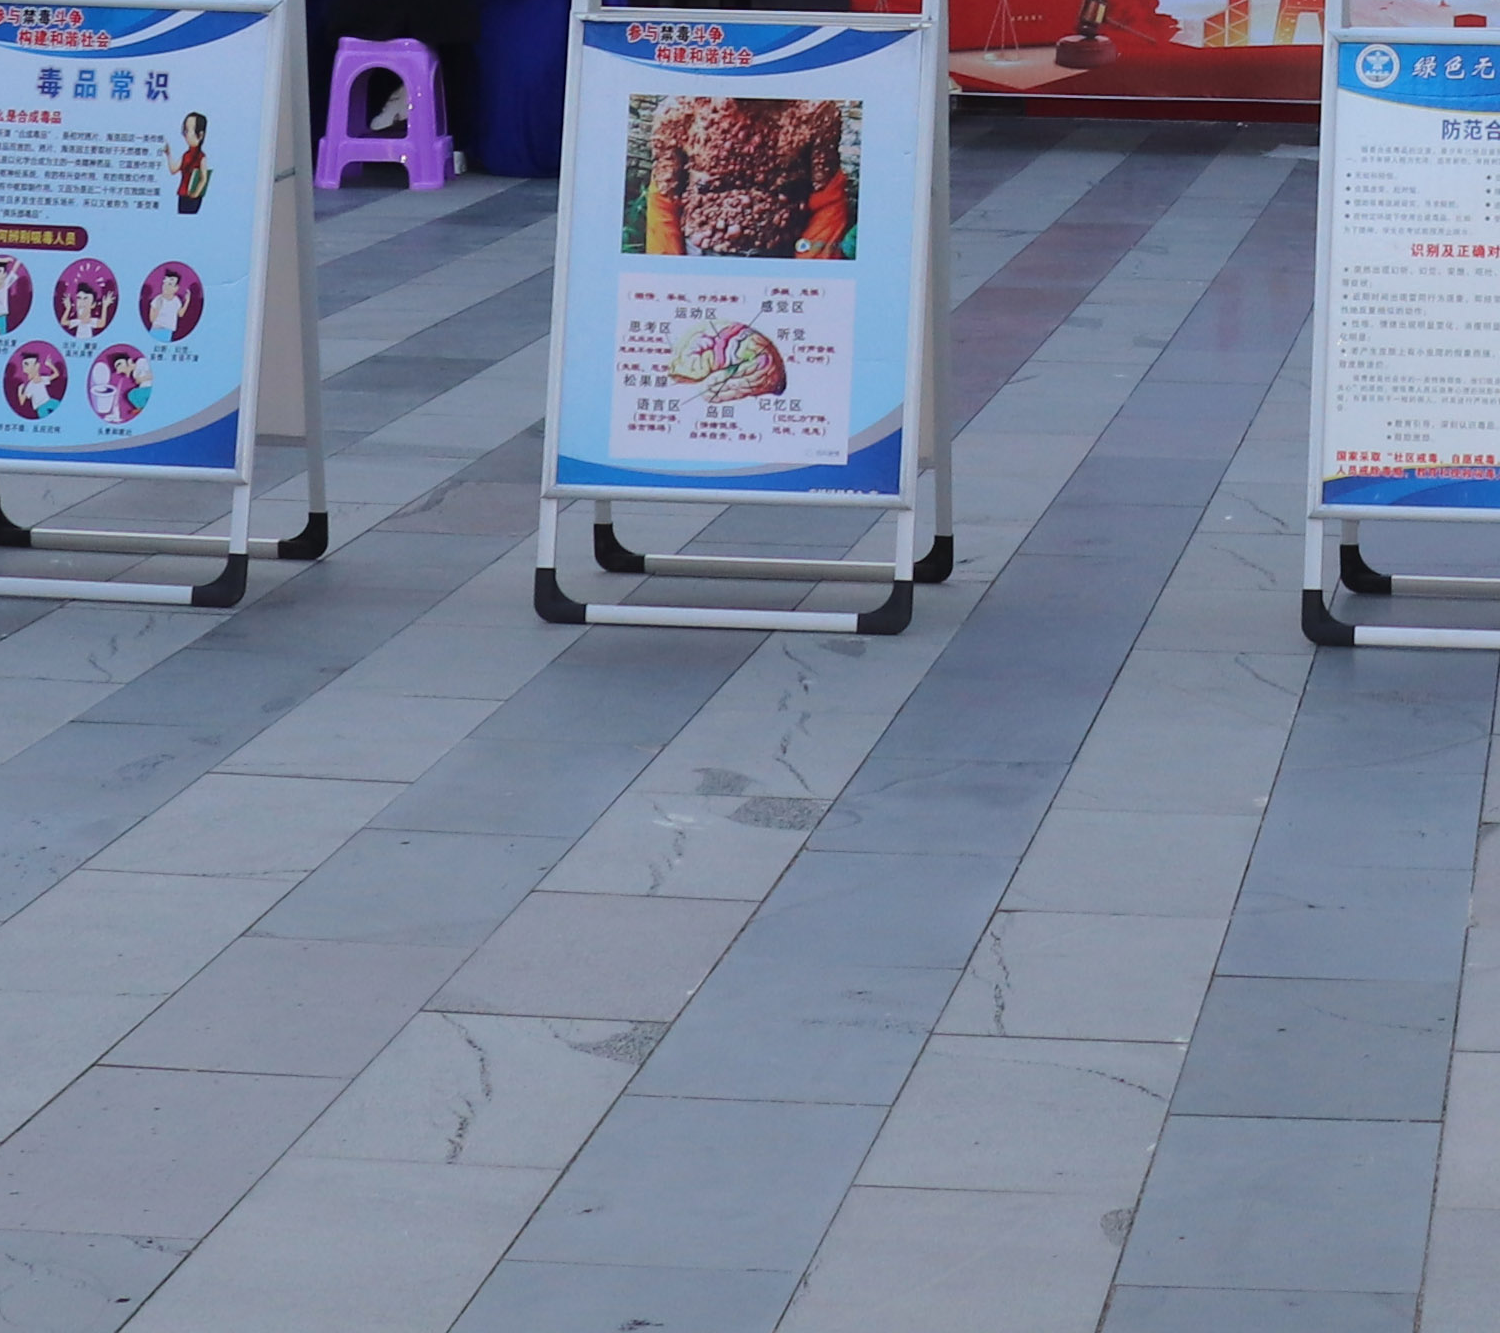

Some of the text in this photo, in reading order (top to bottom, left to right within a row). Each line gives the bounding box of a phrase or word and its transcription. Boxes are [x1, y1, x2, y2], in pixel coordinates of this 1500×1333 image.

[17, 30, 111, 49] 构建和谐社会
[626, 23, 724, 44] 参与禁毒斗争
[656, 45, 754, 67] 构建和谐社会
[37, 67, 169, 101] 毒品常识
[675, 307, 717, 320] 运动区
[760, 300, 804, 314] 感觉区
[629, 321, 671, 334] 思考区
[777, 328, 806, 341] 听觉
[623, 374, 668, 388] 松果腺
[637, 398, 681, 412] 语言区
[706, 405, 735, 419] 岛回
[758, 399, 802, 412] 记忆区
